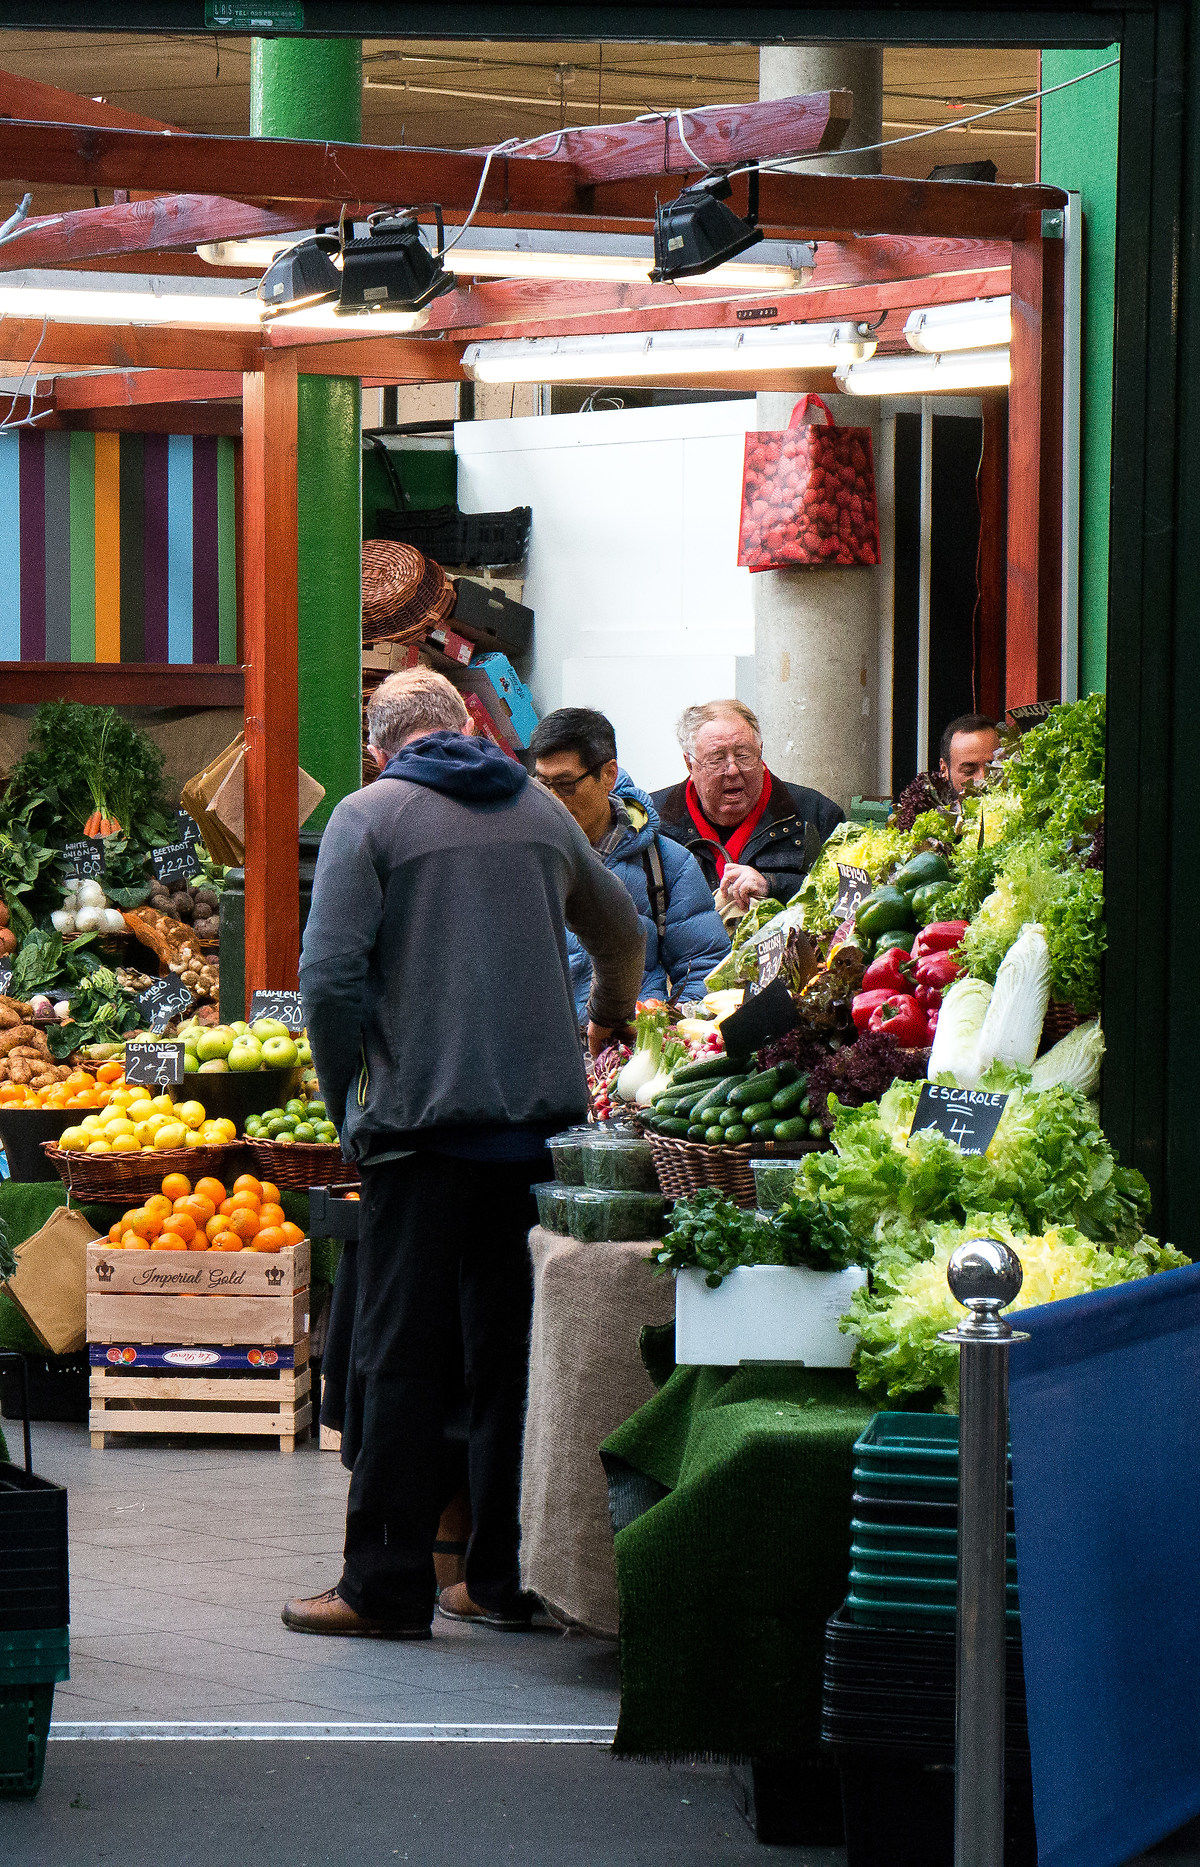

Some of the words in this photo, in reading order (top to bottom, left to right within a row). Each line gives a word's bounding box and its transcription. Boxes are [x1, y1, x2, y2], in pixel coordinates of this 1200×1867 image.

[128, 1043, 178, 1053] LEMONS
[126, 1056, 144, 1083] 2
[132, 1267, 203, 1288] Imperial
[207, 1268, 247, 1289] Gold
